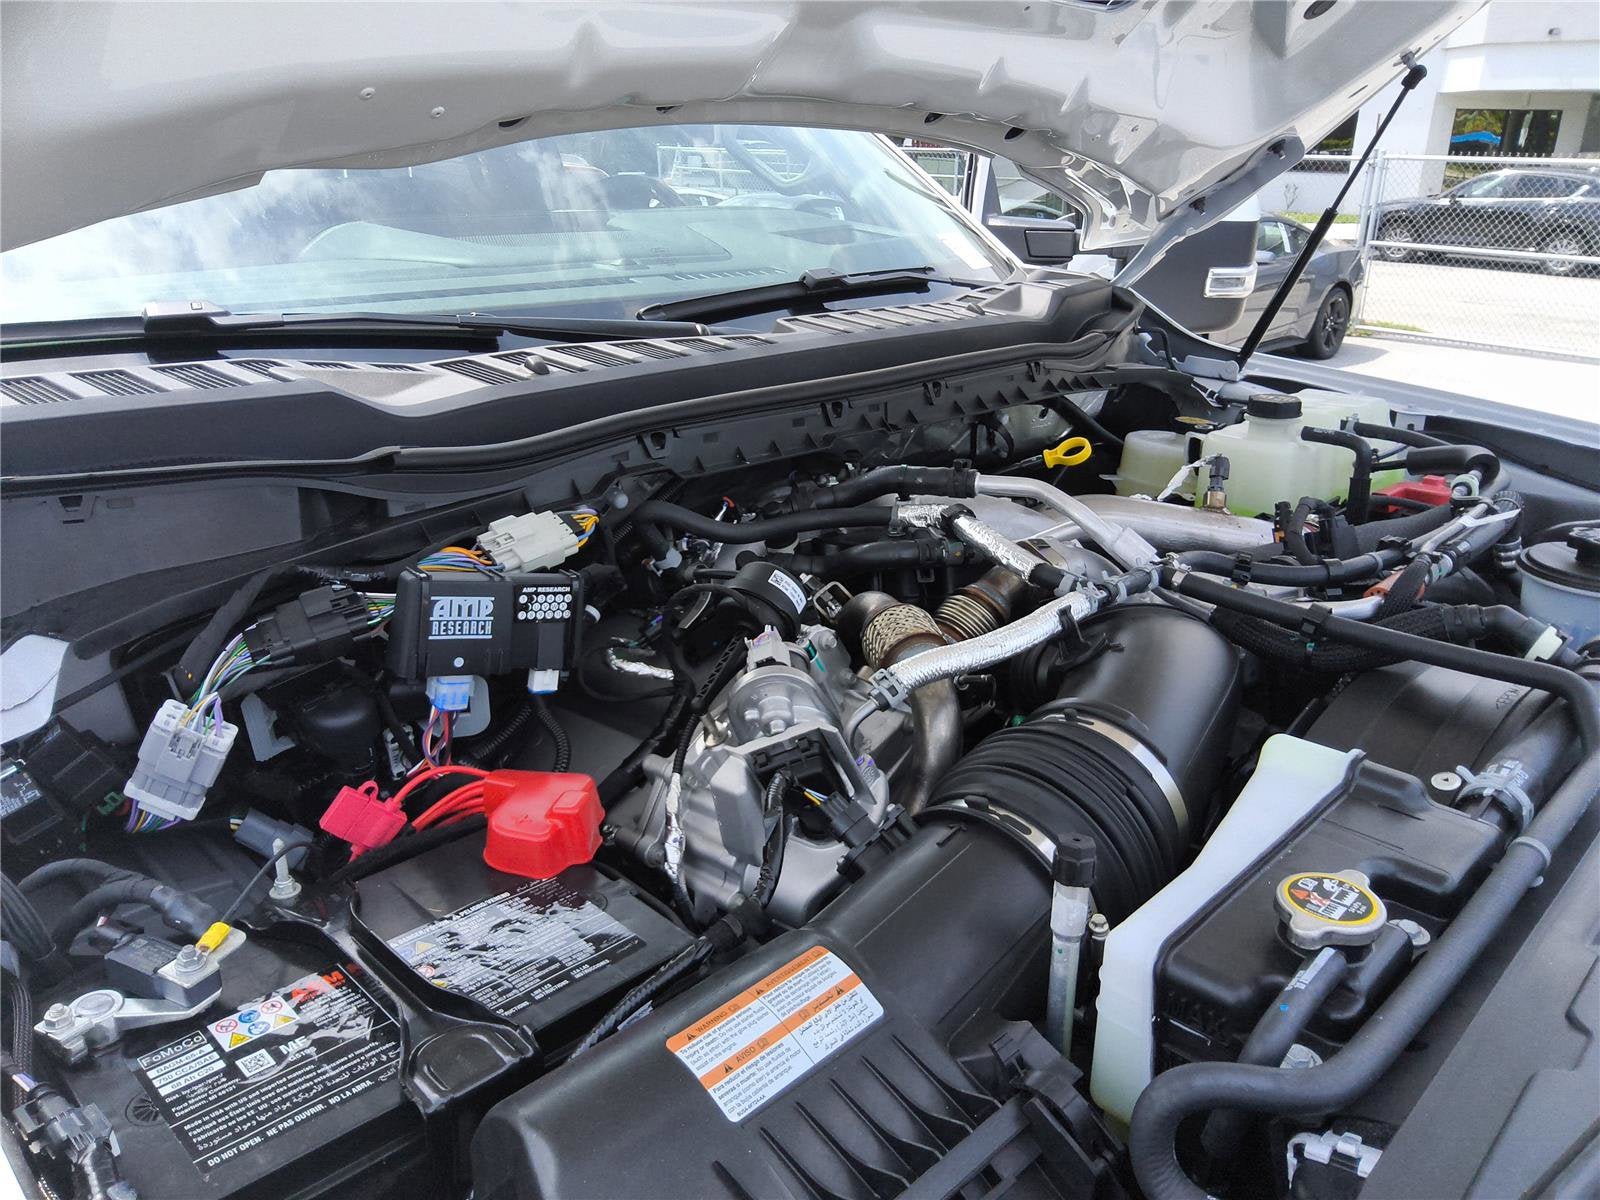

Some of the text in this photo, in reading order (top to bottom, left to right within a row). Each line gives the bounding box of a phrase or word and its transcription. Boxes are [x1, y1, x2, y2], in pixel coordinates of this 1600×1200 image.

[432, 598, 495, 618] AMP
[432, 621, 492, 635] RESEARCH
[695, 1009, 729, 1033] WARNING
[140, 1033, 204, 1067] FoMoCo
[733, 1044, 757, 1063] AVISO
[156, 1054, 215, 1084] 750 CCA/SAE
[169, 1080, 182, 1090] 68
[181, 1074, 196, 1084] Ah
[195, 1064, 215, 1077] C20
[170, 1101, 189, 1113] Ford
[187, 1091, 208, 1104] Motor
[183, 1118, 202, 1130] Made
[209, 1107, 224, 1118] USA
[222, 1100, 238, 1111] with
[236, 1096, 248, 1104] US
[247, 1090, 260, 1099] and
[258, 1076, 287, 1093] imported
[286, 1063, 317, 1080] materials.
[206, 1078, 375, 1167] DO NOT OPEN. NE PAS OUVRIR. NO LA ABRA.
